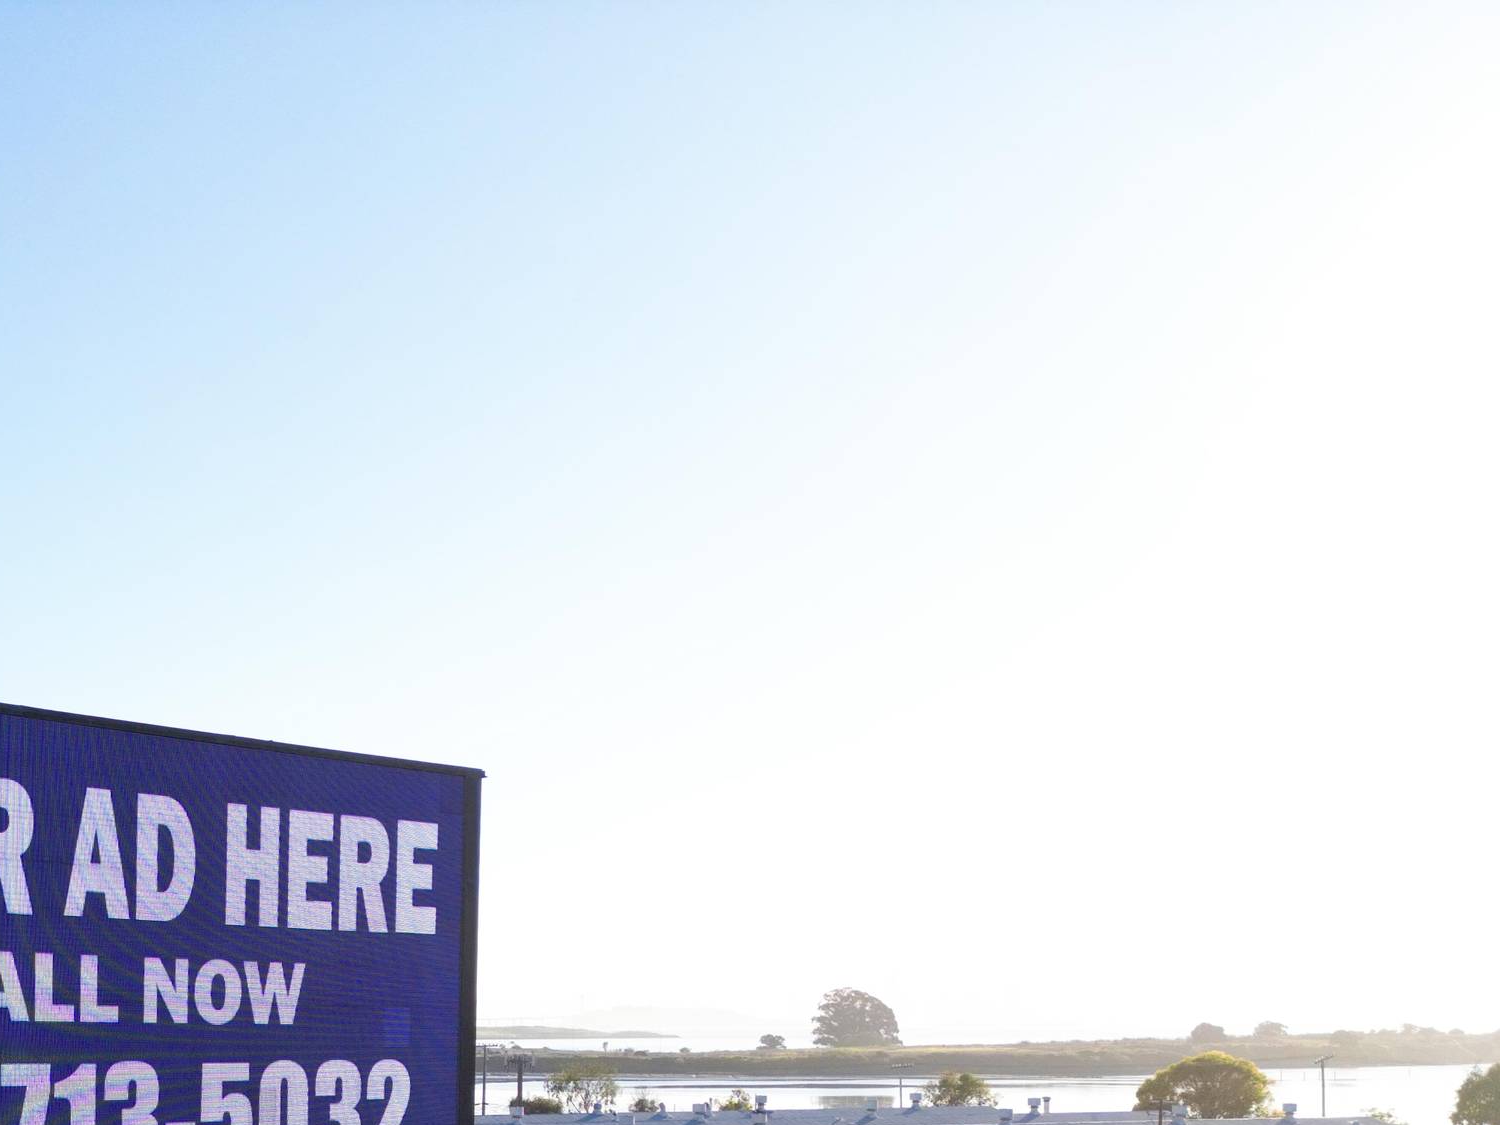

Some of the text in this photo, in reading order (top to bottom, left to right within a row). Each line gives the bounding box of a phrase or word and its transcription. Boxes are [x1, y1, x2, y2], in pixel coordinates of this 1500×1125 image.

[63, 787, 196, 921] AD
[225, 803, 439, 934] HERE
[143, 957, 306, 1025] NOW
